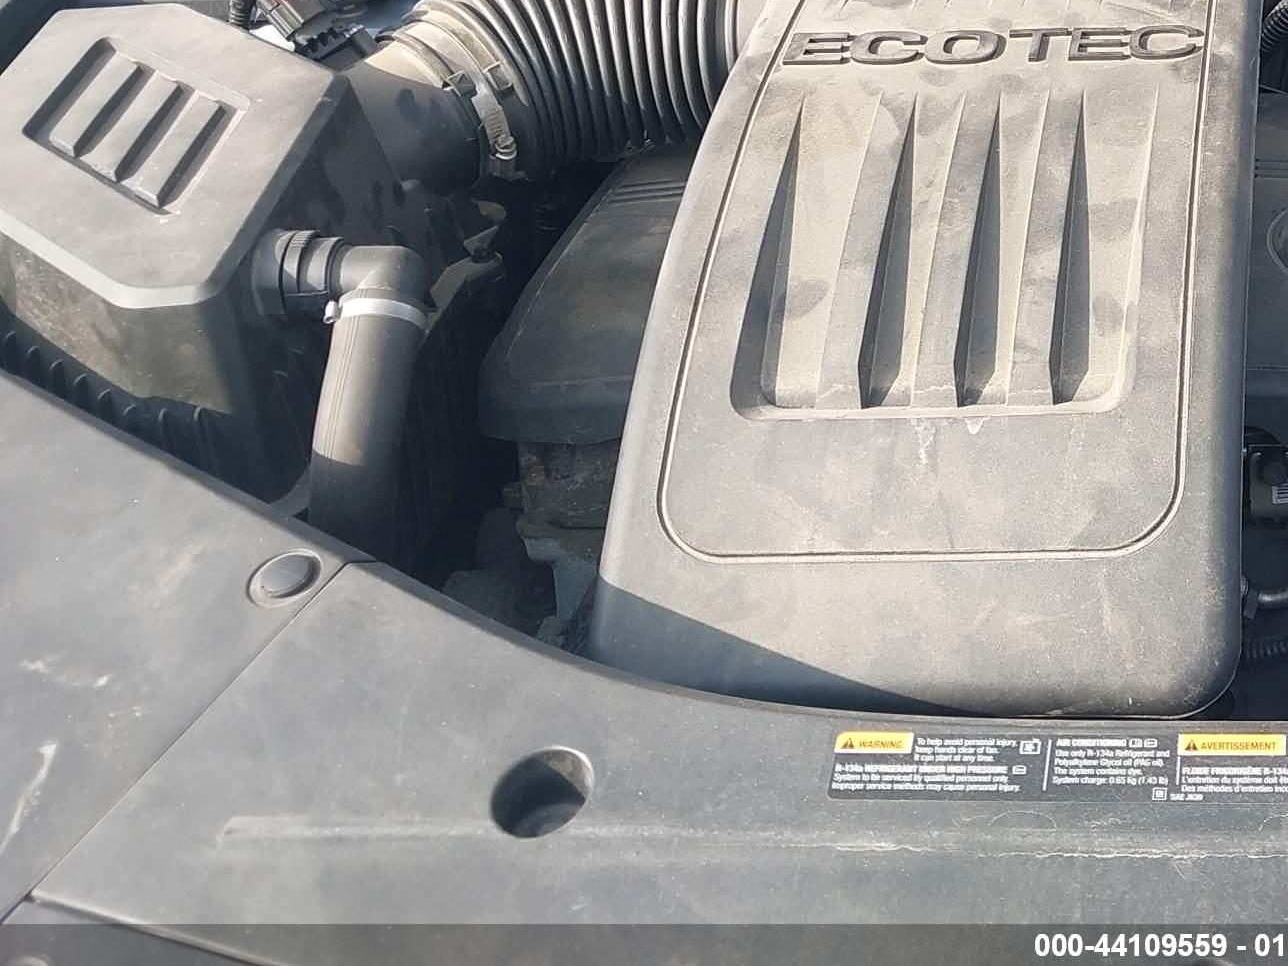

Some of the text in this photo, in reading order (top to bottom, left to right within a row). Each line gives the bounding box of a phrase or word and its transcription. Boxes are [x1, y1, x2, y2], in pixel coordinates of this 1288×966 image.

[782, 26, 1201, 64] ECOTEC
[859, 740, 902, 749] WARNING
[927, 738, 943, 747] help
[964, 738, 995, 747] personal
[1201, 742, 1276, 750] AVERTISSEMENT
[1055, 749, 1069, 757] Use
[1070, 750, 1086, 758] only
[1087, 749, 1114, 757] R-134a
[1115, 750, 1155, 758] Refrigerant
[1069, 768, 1095, 776] system
[1128, 768, 1143, 776] dye.
[833, 773, 861, 782] System
[881, 774, 912, 782] serviced
[913, 775, 922, 783] by
[924, 775, 955, 783] qualified
[955, 775, 991, 784] personnel
[832, 782, 864, 791] Improper
[865, 782, 892, 790] service
[926, 784, 941, 792] may
[966, 784, 997, 792] personal
[998, 784, 1021, 793] injury.
